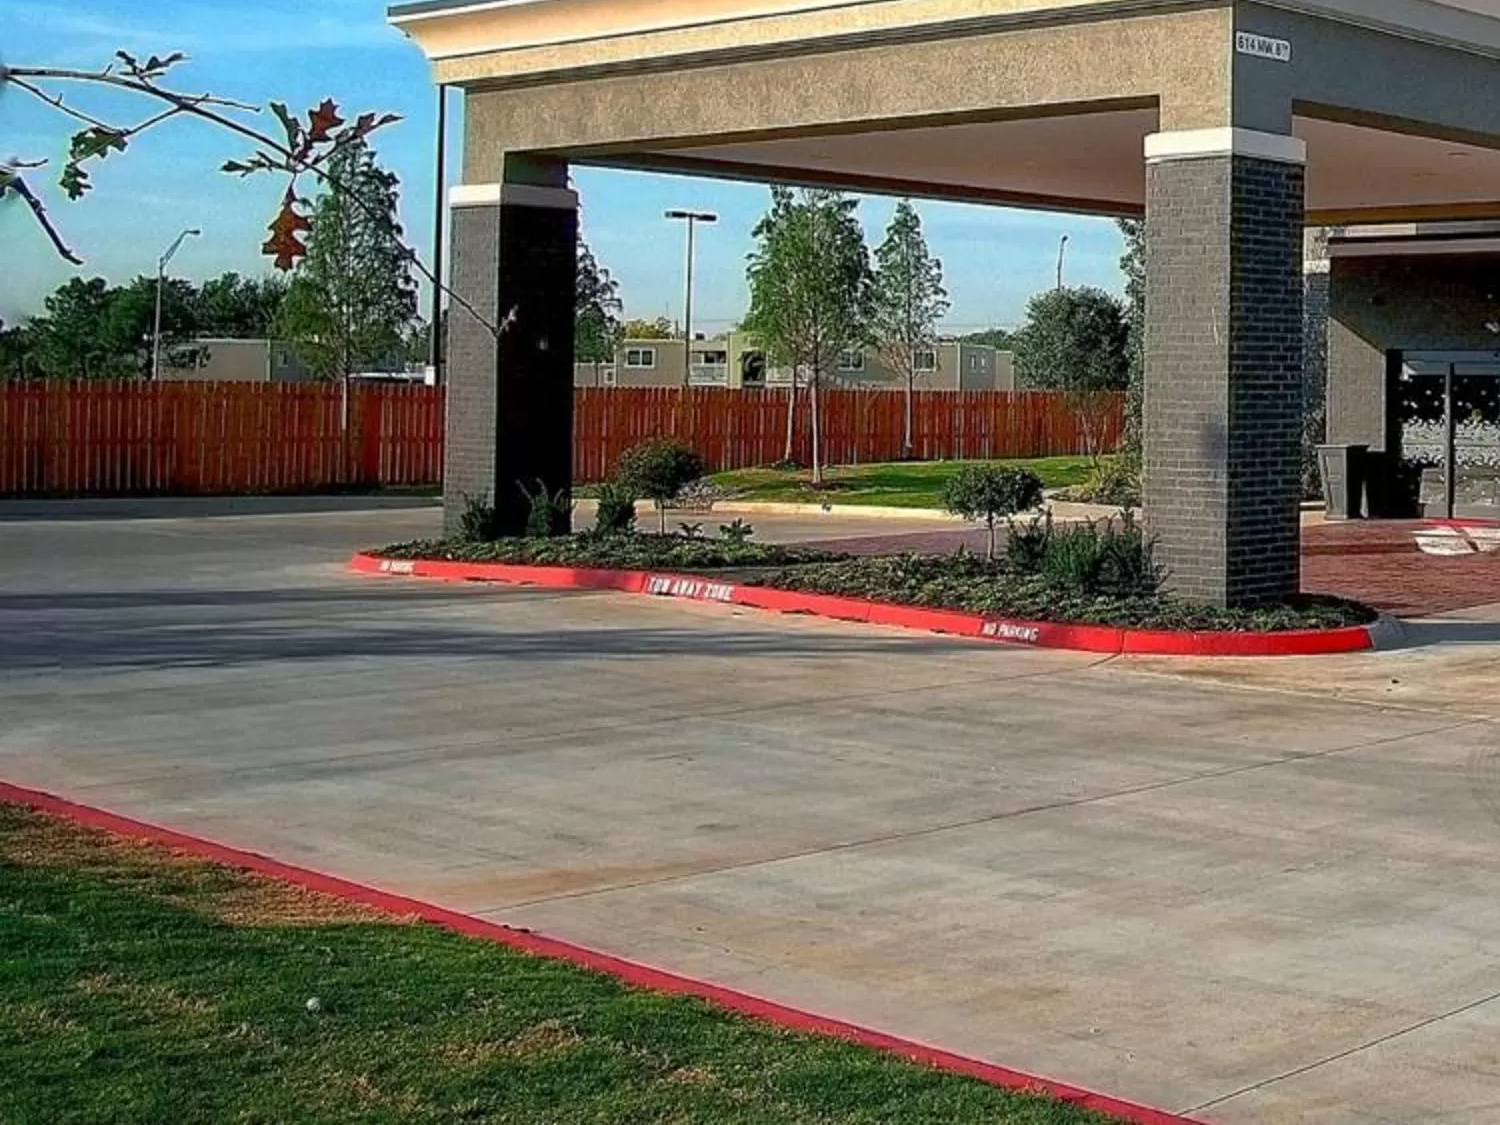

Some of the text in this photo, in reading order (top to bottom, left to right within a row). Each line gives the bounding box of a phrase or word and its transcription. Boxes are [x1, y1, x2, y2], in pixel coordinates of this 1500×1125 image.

[647, 576, 735, 602] TOW AWAY ZONE
